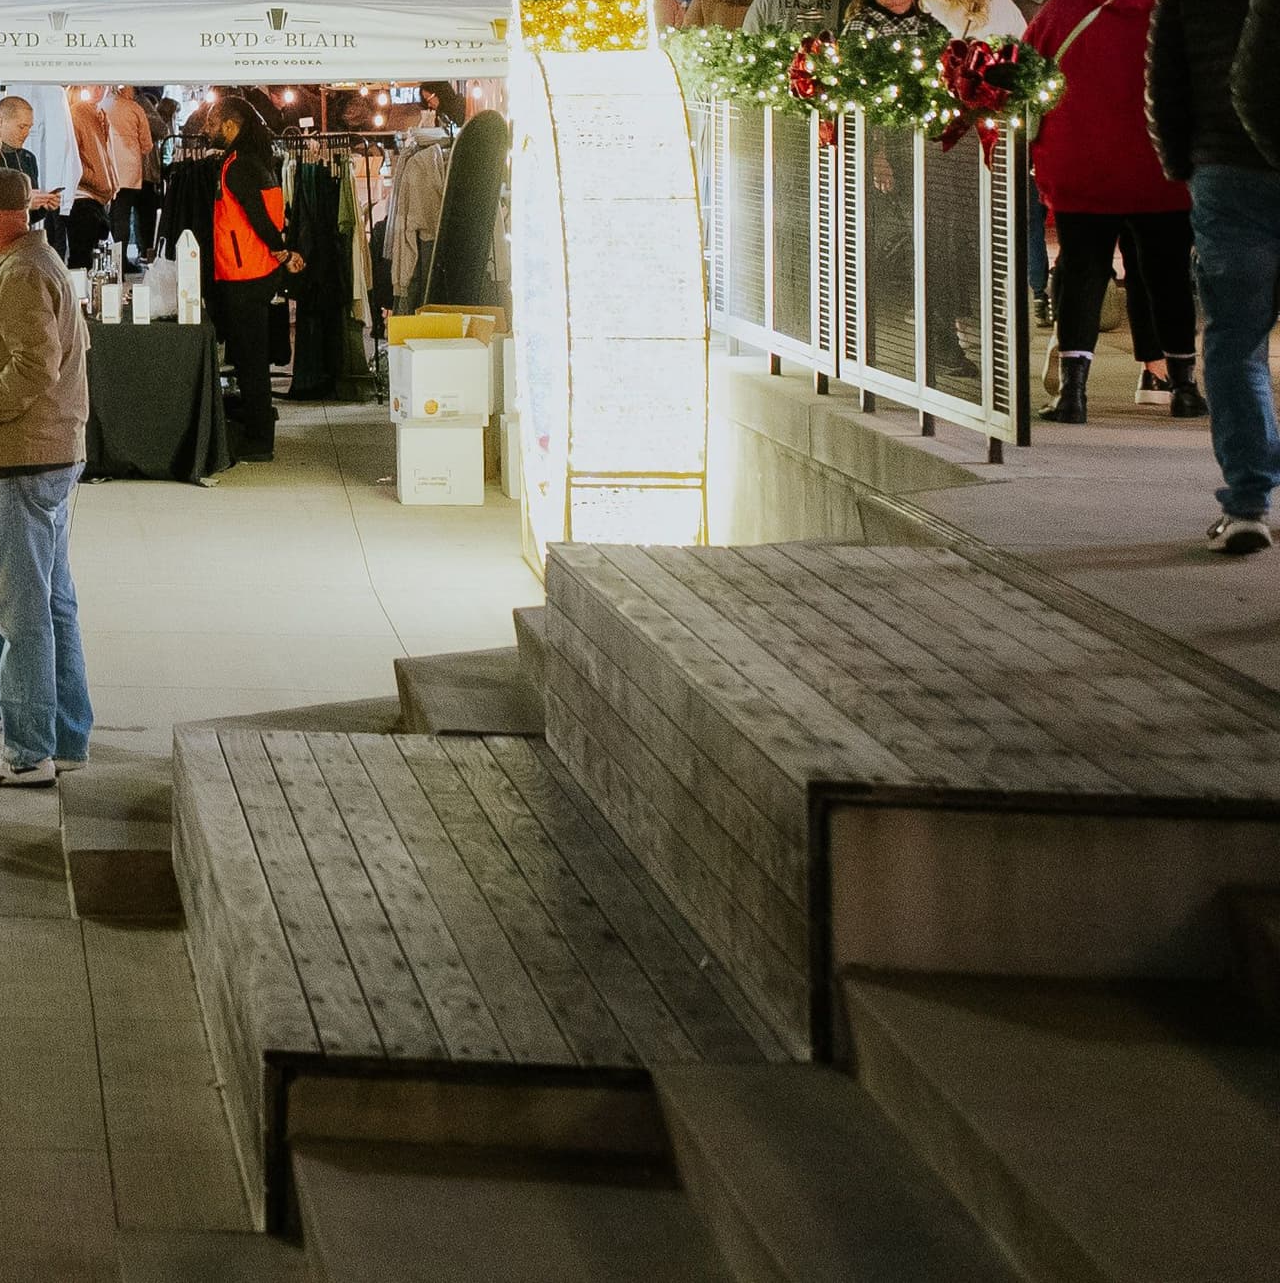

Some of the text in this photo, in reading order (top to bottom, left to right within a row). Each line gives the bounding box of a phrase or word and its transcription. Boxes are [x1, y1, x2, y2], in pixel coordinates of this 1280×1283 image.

[64, 33, 137, 48] BLAIR
[200, 32, 258, 48] BOYD
[284, 33, 357, 48] BLAIR
[424, 38, 483, 50] BOYD
